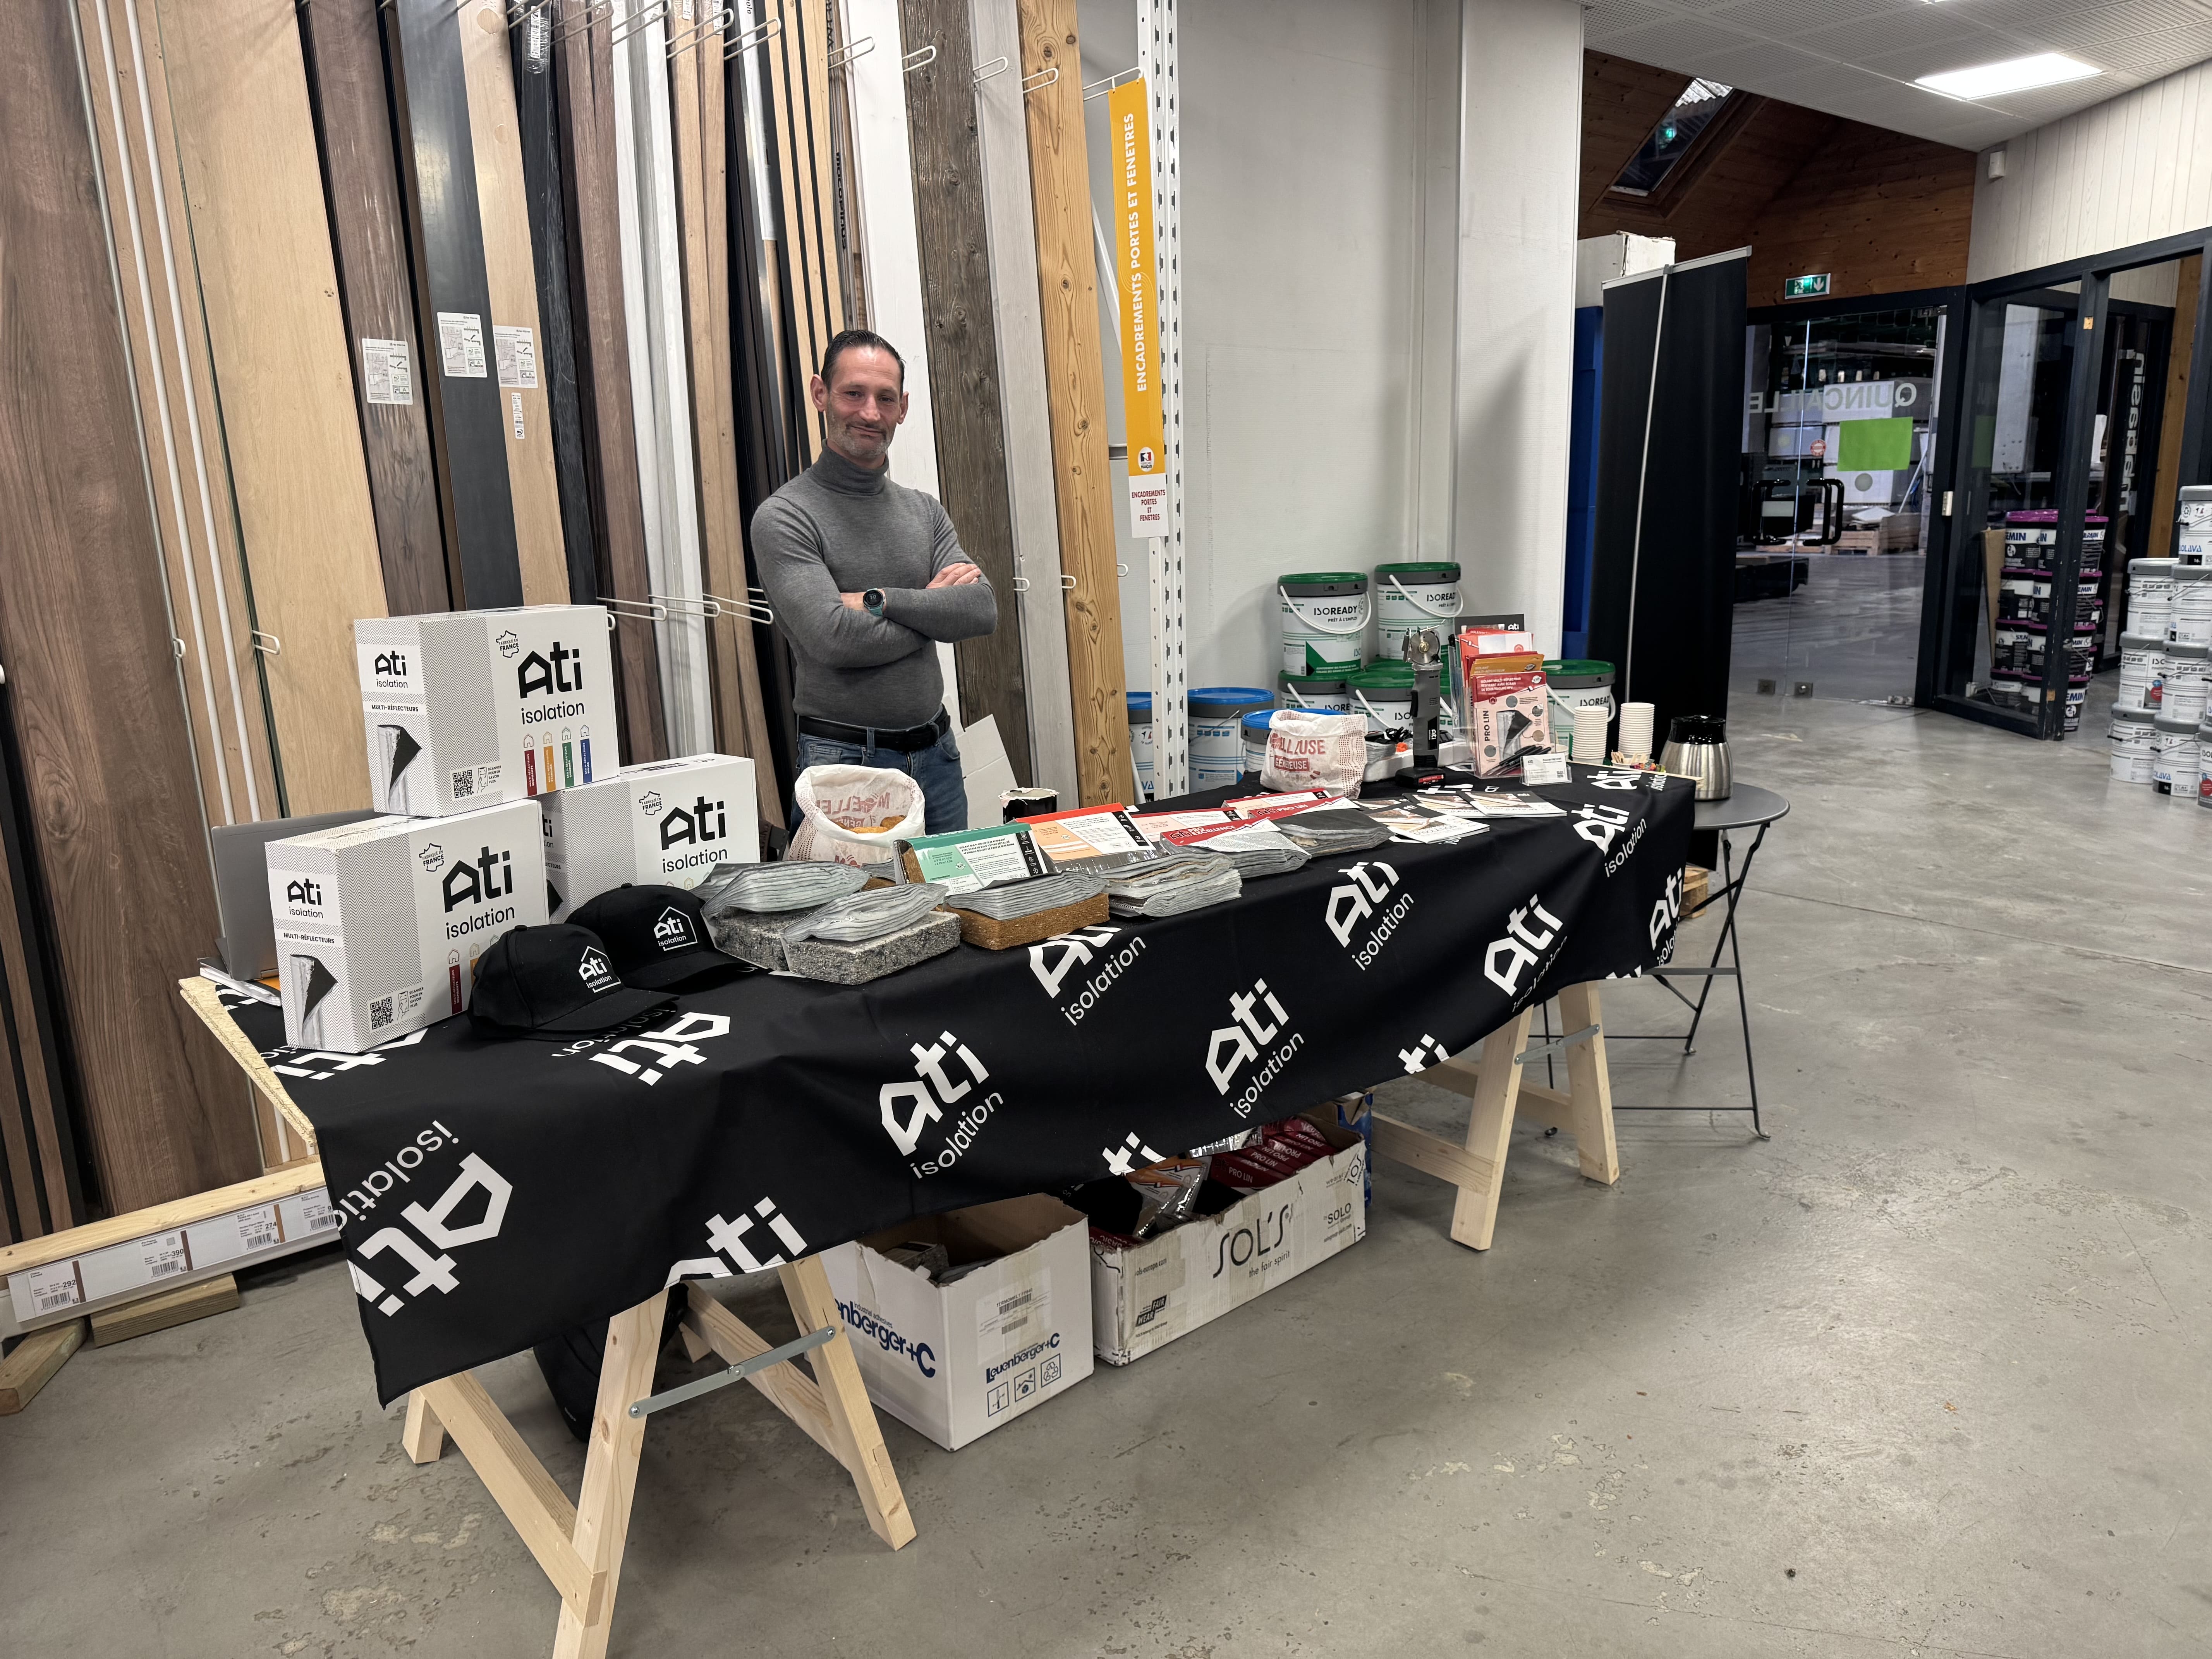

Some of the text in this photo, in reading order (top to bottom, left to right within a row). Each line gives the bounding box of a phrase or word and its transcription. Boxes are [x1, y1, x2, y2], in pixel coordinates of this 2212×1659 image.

[1123, 113, 1147, 392] ENCADREMENTS PORTES ET FENETRES
[1132, 489, 1166, 498] ENCADREMENTS
[1314, 605, 1358, 615] ISOREADY
[500, 642, 519, 651] FRANCE
[375, 650, 407, 676] Ati
[517, 642, 582, 699] Ati
[376, 679, 408, 689] isolation
[371, 704, 419, 712] MULTI-RÉFLECTEURS
[522, 701, 585, 725] isolation
[642, 802, 663, 811] FRANCE
[543, 814, 553, 838] ti
[659, 796, 726, 850] Ati
[1193, 825, 1237, 836] EXCELLENCE
[1604, 817, 1647, 878] isolation
[423, 854, 444, 867] FRANCE
[663, 849, 728, 873] isolation
[441, 846, 513, 913] Ati
[287, 878, 322, 906] Ati
[289, 906, 324, 919] isolation
[445, 905, 515, 940] isolation
[283, 932, 335, 944] MULTI-RÉFLECTEURS
[653, 916, 684, 939] Ati
[1352, 892, 1414, 971] isolation
[658, 935, 687, 947] isolation
[1484, 893, 1563, 997] Ati
[578, 957, 608, 981] Ati
[1512, 936, 1567, 1012] isolation
[586, 974, 612, 989] isolation
[1061, 936, 1147, 1026] isolation
[1205, 977, 1289, 1096] Ati
[1230, 1032, 1304, 1119] isolation
[879, 1030, 989, 1156] Ati
[910, 1092, 1004, 1179] isolation
[1296, 1133, 1325, 1147] PRO LIN
[1251, 1152, 1267, 1163] PRO
[1266, 1158, 1278, 1167] LIN
[1262, 1146, 1289, 1162] PRO LIN
[1228, 1166, 1253, 1183] PRO LIN
[1328, 1202, 1351, 1224] SOLO
[265, 1221, 277, 1229] 274
[346, 1152, 513, 1317] Ati
[172, 1249, 184, 1257] 390
[1213, 1204, 1289, 1279] SOL'S
[1249, 1250, 1290, 1278] the fair spirit
[62, 1279, 76, 1288] 292
[854, 1301, 872, 1317] industrial
[1152, 1297, 1165, 1310] FAIR
[1138, 1310, 1154, 1325] WEAR
[986, 1333, 1060, 1384] Leuenberger+C
